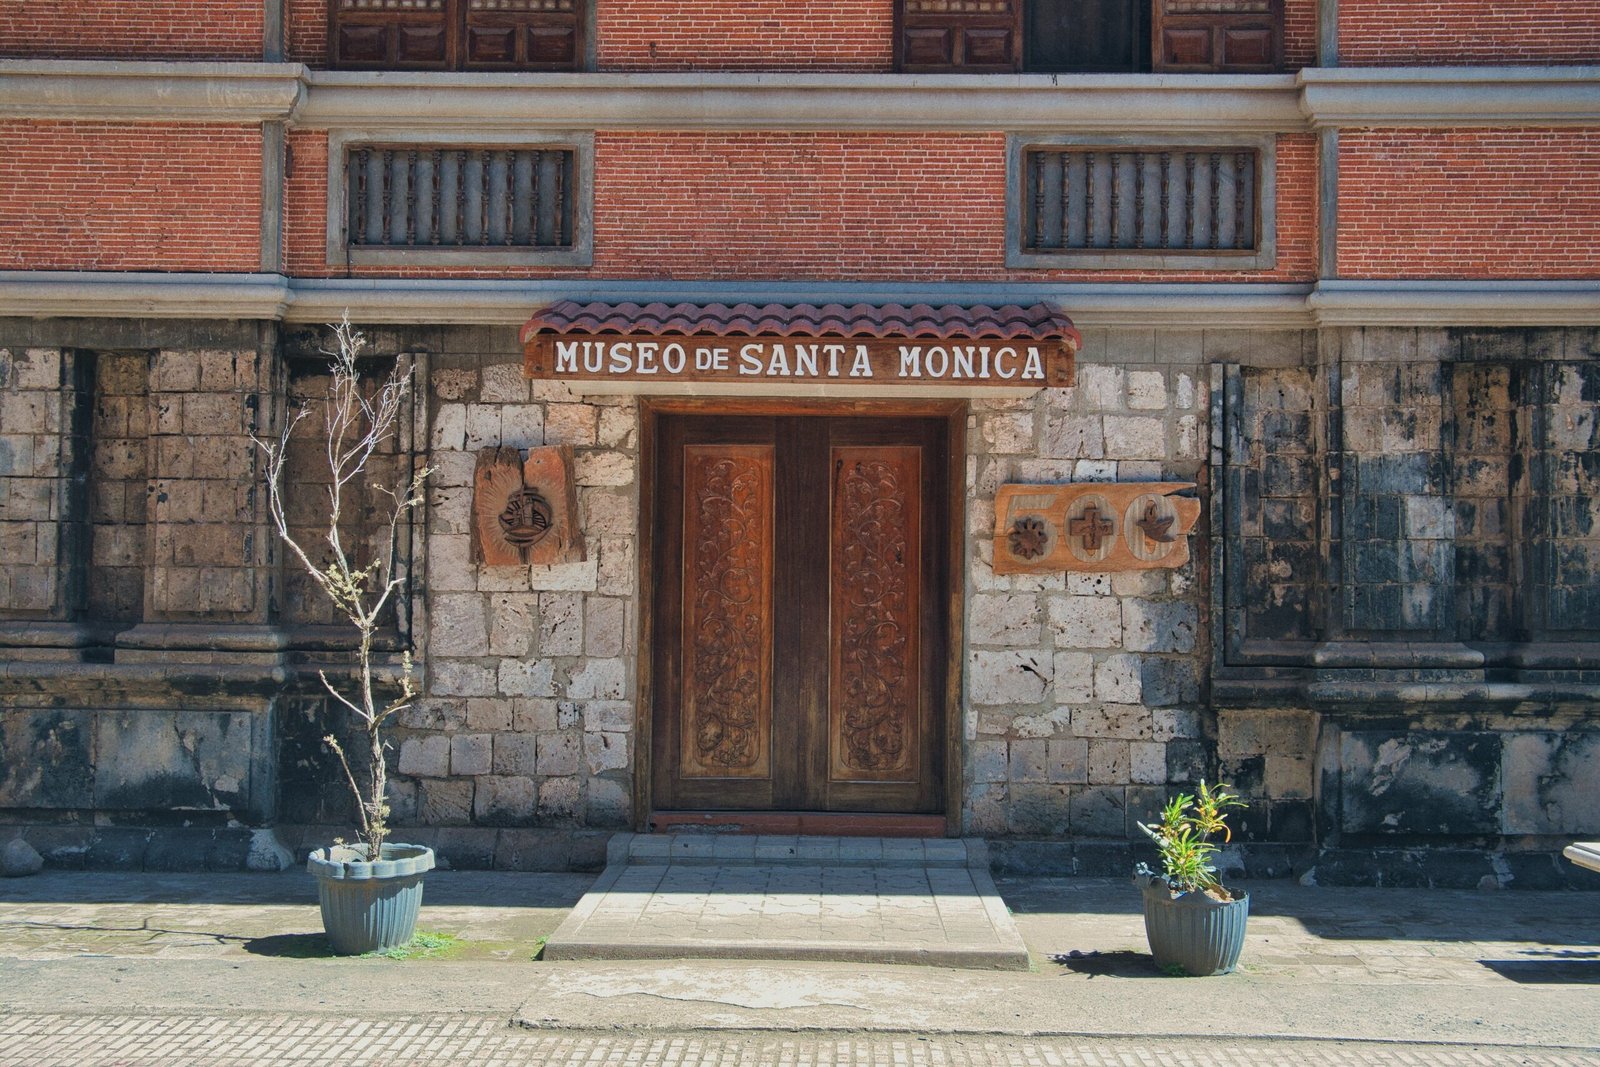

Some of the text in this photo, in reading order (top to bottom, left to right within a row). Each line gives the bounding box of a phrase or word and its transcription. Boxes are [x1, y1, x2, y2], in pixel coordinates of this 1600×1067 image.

[555, 341, 1045, 379] MUSEO DE SANTA MONICA
